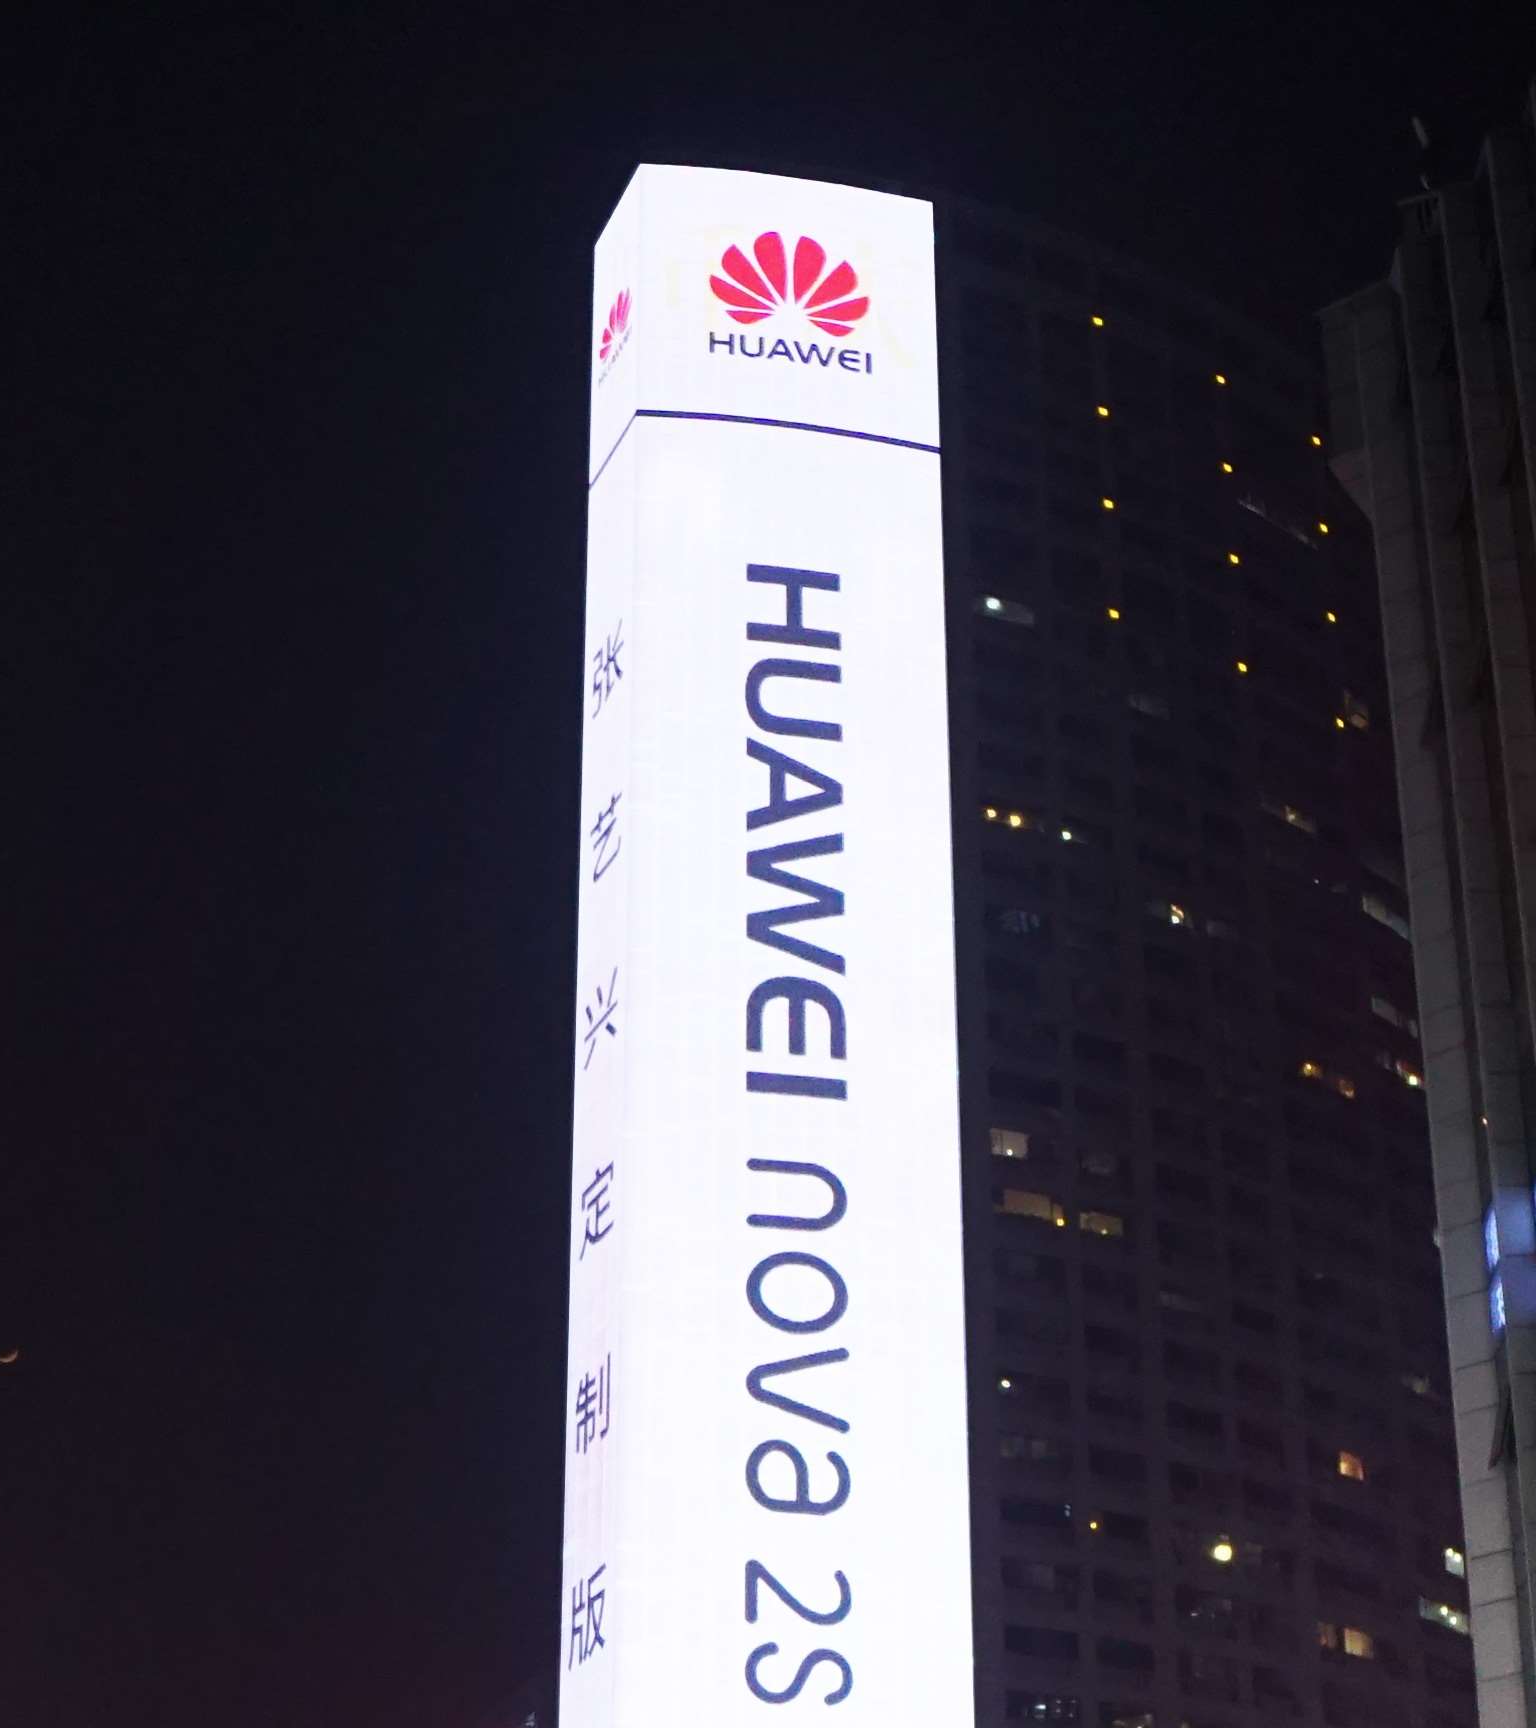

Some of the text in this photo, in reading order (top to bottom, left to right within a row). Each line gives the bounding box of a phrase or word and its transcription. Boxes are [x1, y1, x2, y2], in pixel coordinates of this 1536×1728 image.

[708, 331, 873, 375] HUAWEI
[745, 563, 854, 1706] HUAWEI nova 2S
